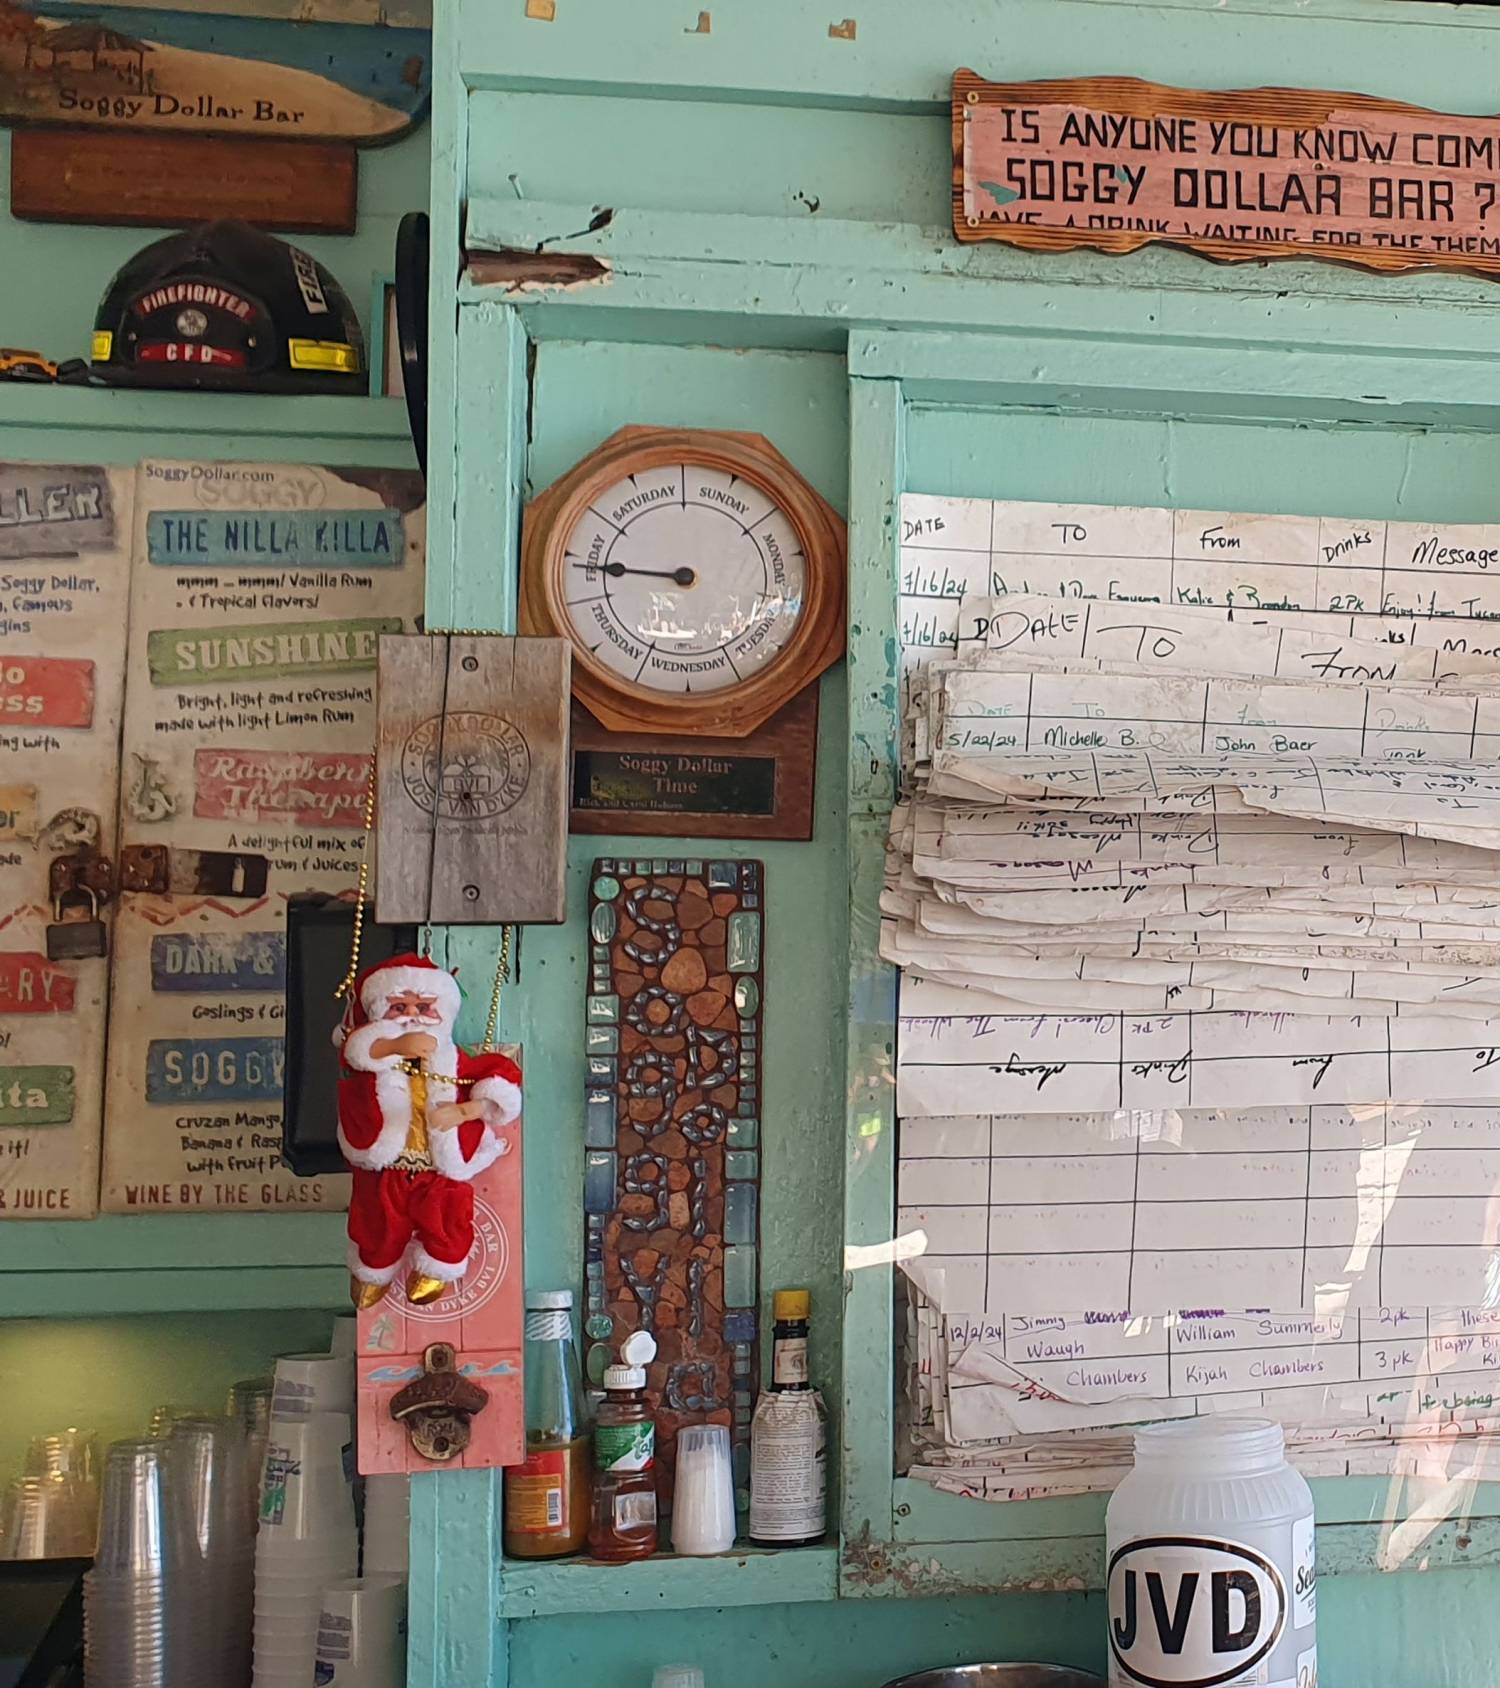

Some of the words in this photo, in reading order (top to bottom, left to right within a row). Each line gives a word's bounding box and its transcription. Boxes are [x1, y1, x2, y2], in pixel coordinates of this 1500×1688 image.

[59, 88, 142, 118] Soggy
[153, 94, 243, 119] Dollar
[252, 100, 304, 123] Bar
[1001, 107, 1042, 145] IS
[1060, 112, 1197, 154] ANYONE
[1209, 120, 1279, 158] YOU
[1293, 128, 1397, 164] KNOW
[1005, 156, 1147, 205] SOGGY
[1173, 168, 1343, 218] DOLLAR
[1369, 178, 1456, 224] BAR
[1431, 236, 1500, 256] THEM
[142, 283, 251, 318] FIREFIGHTER
[146, 464, 275, 483] SoggyDollar.com
[612, 484, 677, 522] SATURDAY
[699, 485, 751, 515] SUNDAY
[163, 519, 208, 553] THE
[224, 520, 299, 553] NILLA
[316, 521, 390, 553] KILLA
[903, 517, 945, 542] DATE
[1050, 523, 1087, 542] TO
[1200, 526, 1241, 549] From
[1321, 530, 1372, 563] Drinks
[1412, 536, 1500, 569] Message
[585, 533, 606, 583] FRIDAY
[763, 532, 786, 588] MONDAY
[290, 573, 337, 588] Vanilla
[341, 573, 372, 588] Rum
[199, 593, 257, 612] Tropical
[590, 603, 644, 662] THURSDAY
[735, 609, 777, 658] TUESDAY
[176, 630, 378, 671] SUNSHINE
[650, 655, 727, 673] WEDNESDAY
[177, 693, 228, 711] Bright,
[231, 691, 263, 709] light
[268, 689, 294, 704] and
[297, 687, 374, 703] refreshing
[154, 718, 194, 733] made
[198, 713, 234, 733] with
[237, 713, 271, 731] light
[275, 709, 318, 725] Limon
[322, 707, 355, 724] Rum
[948, 728, 1017, 750] 5/22/24
[1044, 725, 1107, 749] Michelle
[1214, 735, 1256, 752] John
[1273, 735, 1315, 752] Baer
[619, 754, 672, 775] Soggy
[677, 756, 733, 774] Dollar
[653, 776, 698, 794] Time
[227, 833, 238, 849] A
[241, 833, 313, 853] delightful
[316, 838, 347, 852] mix
[181, 1137, 234, 1151] Banana
[187, 1158, 224, 1176] with
[227, 1155, 267, 1174] fruit
[14, 1188, 71, 1209] JUICE
[125, 1184, 172, 1204] WINE
[180, 1184, 203, 1204] BY
[214, 1184, 249, 1204] THE
[261, 1184, 324, 1204] GLASS
[480, 1221, 499, 1254] BAR
[476, 1264, 496, 1289] BVI
[441, 1288, 478, 1312] DYKE
[950, 1321, 1002, 1345] 12/2/24
[1175, 1326, 1237, 1344] William
[1027, 1341, 1085, 1361] Waugh
[1433, 1335, 1475, 1353] Happy
[1066, 1368, 1148, 1387] Chambers
[1185, 1364, 1229, 1384] Kijah
[1113, 1569, 1262, 1655] JVD
